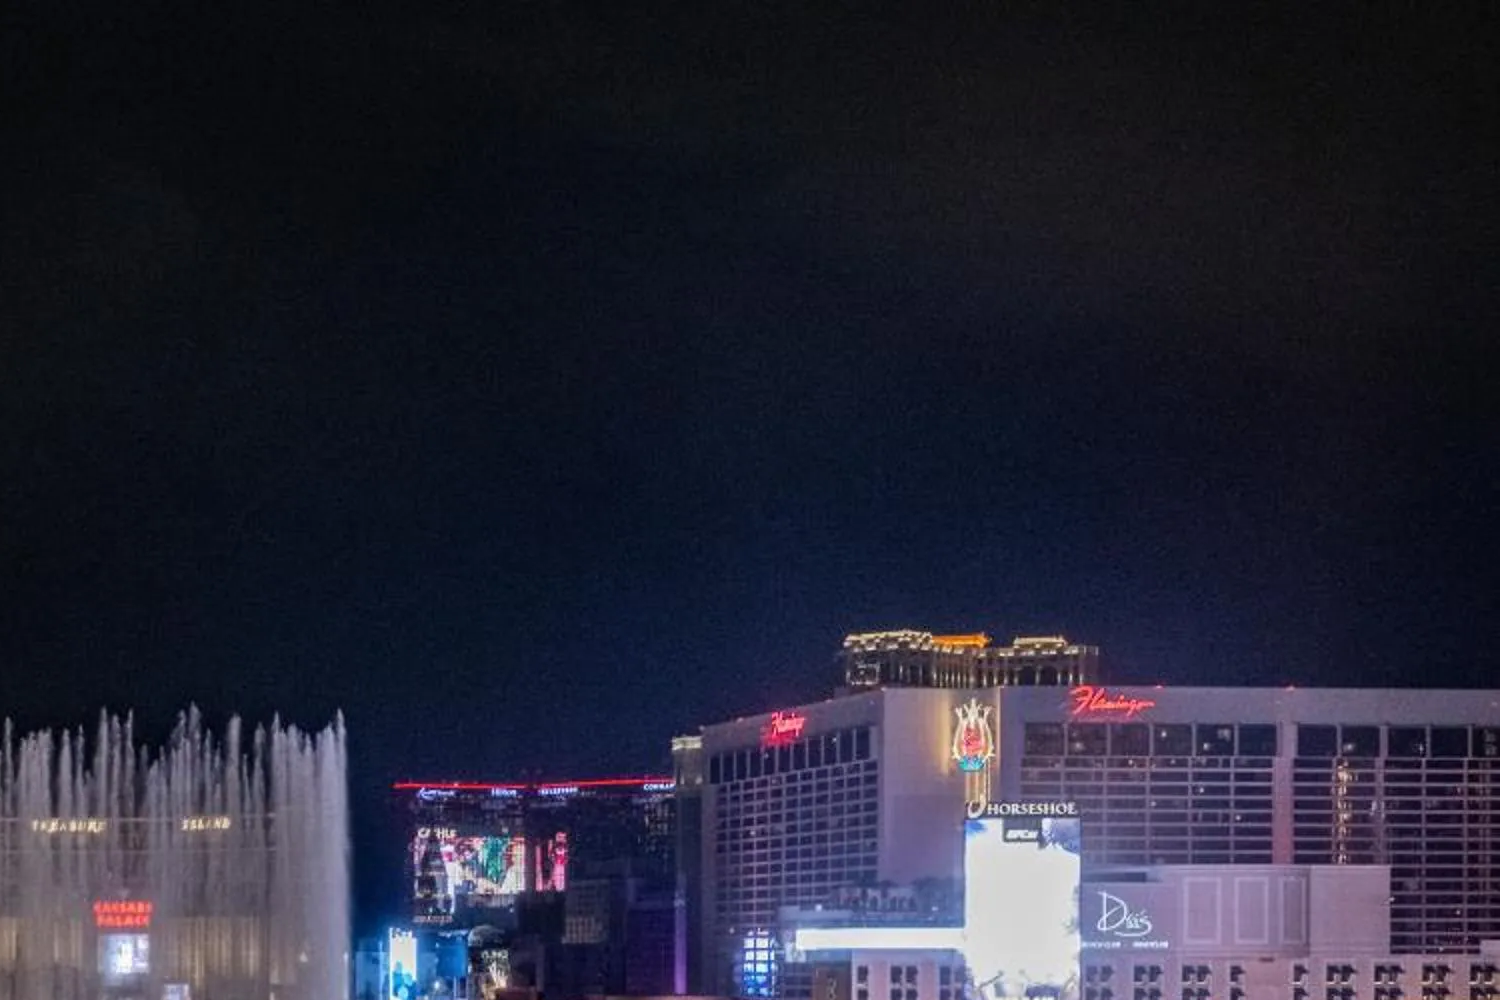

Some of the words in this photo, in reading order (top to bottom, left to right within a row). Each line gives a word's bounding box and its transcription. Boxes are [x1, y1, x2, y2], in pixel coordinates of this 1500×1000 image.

[987, 802, 1079, 815] HORSESHOE
[31, 817, 107, 833] TREASURE
[181, 815, 231, 831] ISLAND
